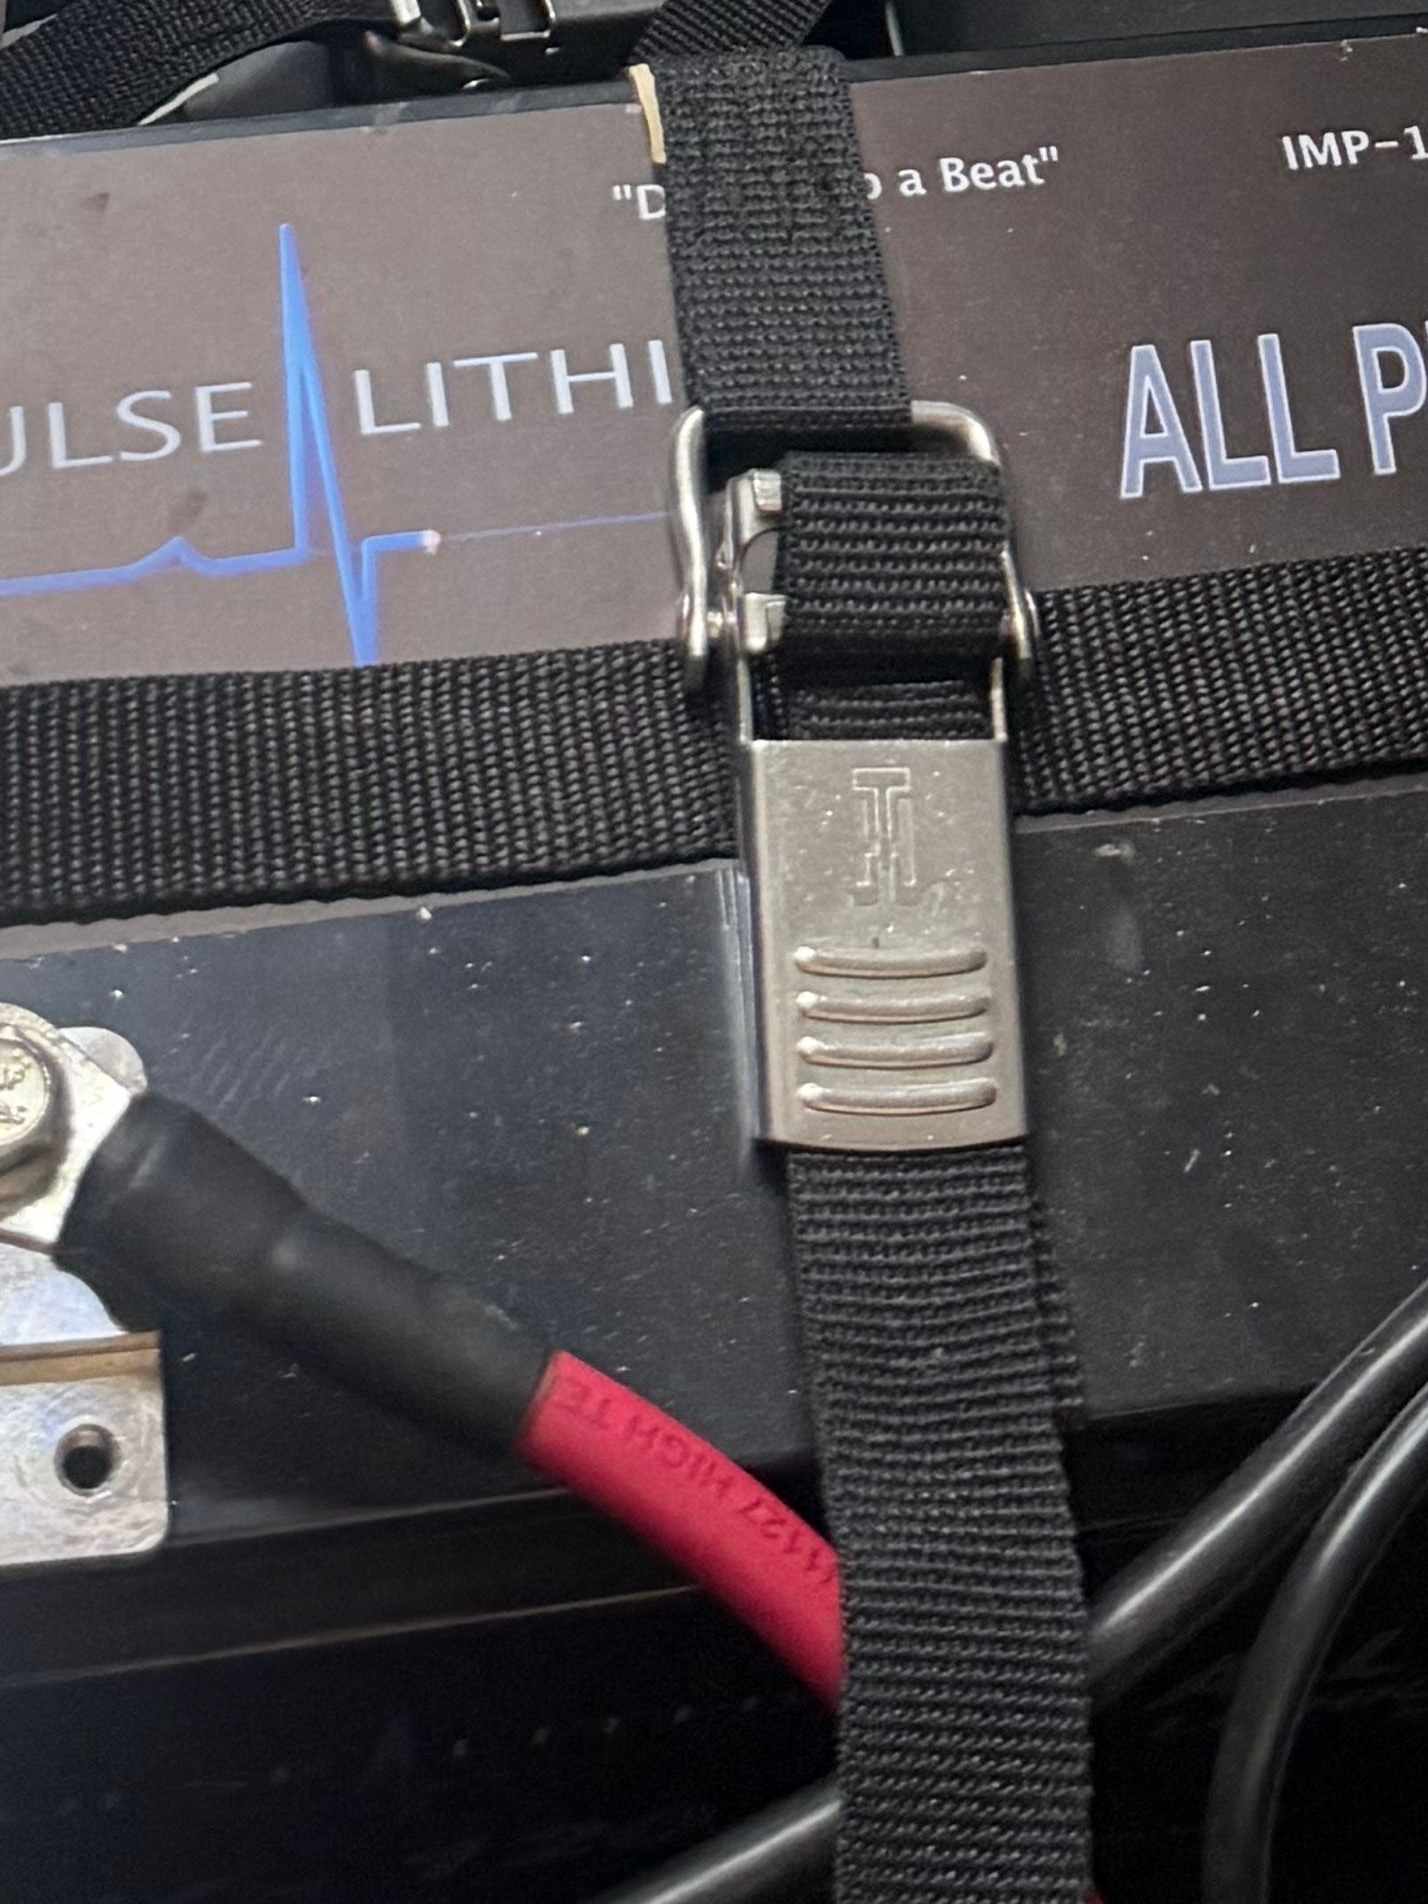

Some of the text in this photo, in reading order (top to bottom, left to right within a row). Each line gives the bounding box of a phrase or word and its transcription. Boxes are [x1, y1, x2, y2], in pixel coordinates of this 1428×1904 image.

[897, 166, 927, 197] a
[938, 145, 1060, 194] Beat"
[352, 339, 672, 440] LITHI
[1119, 332, 1341, 500] ALL
